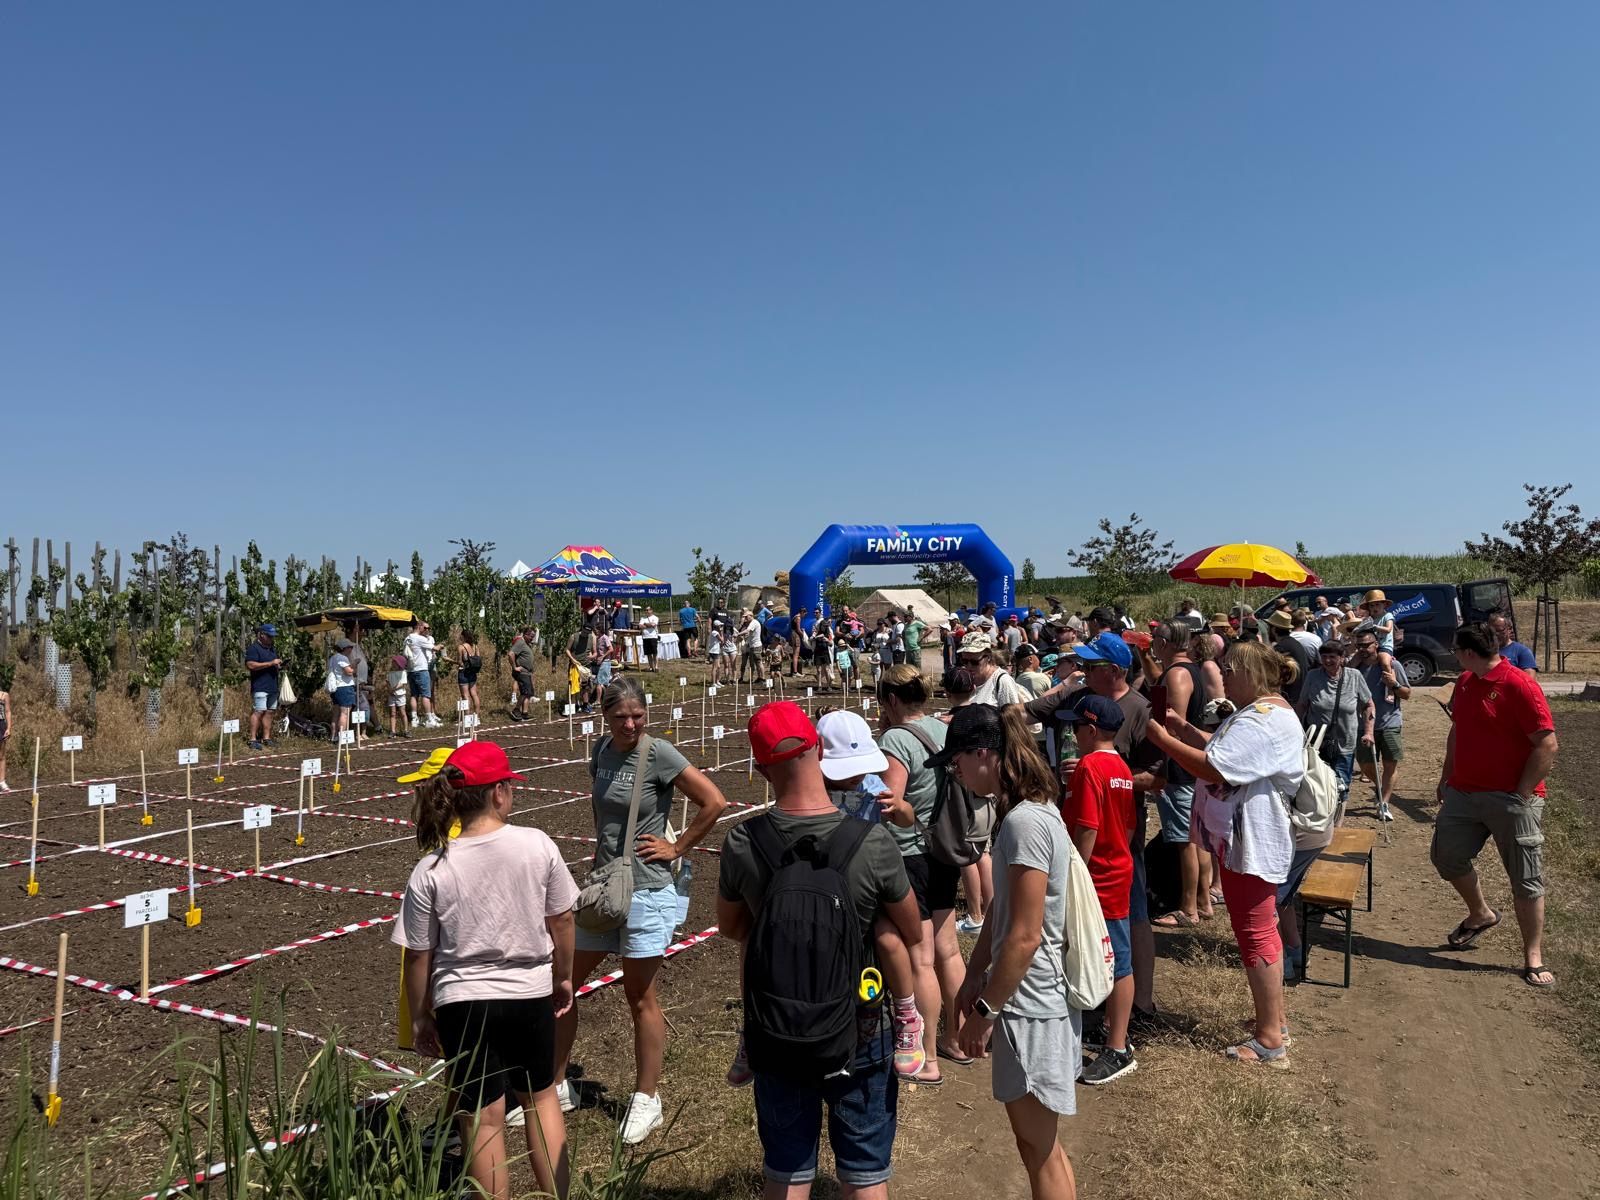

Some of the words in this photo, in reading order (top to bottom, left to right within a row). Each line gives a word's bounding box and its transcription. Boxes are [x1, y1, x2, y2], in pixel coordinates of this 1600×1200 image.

[880, 552, 947, 560] www.familycity.com
[1392, 603, 1411, 617] AMiLY
[144, 899, 151, 907] 5
[135, 905, 159, 915] PARZELLE
[144, 913, 151, 922] 2
